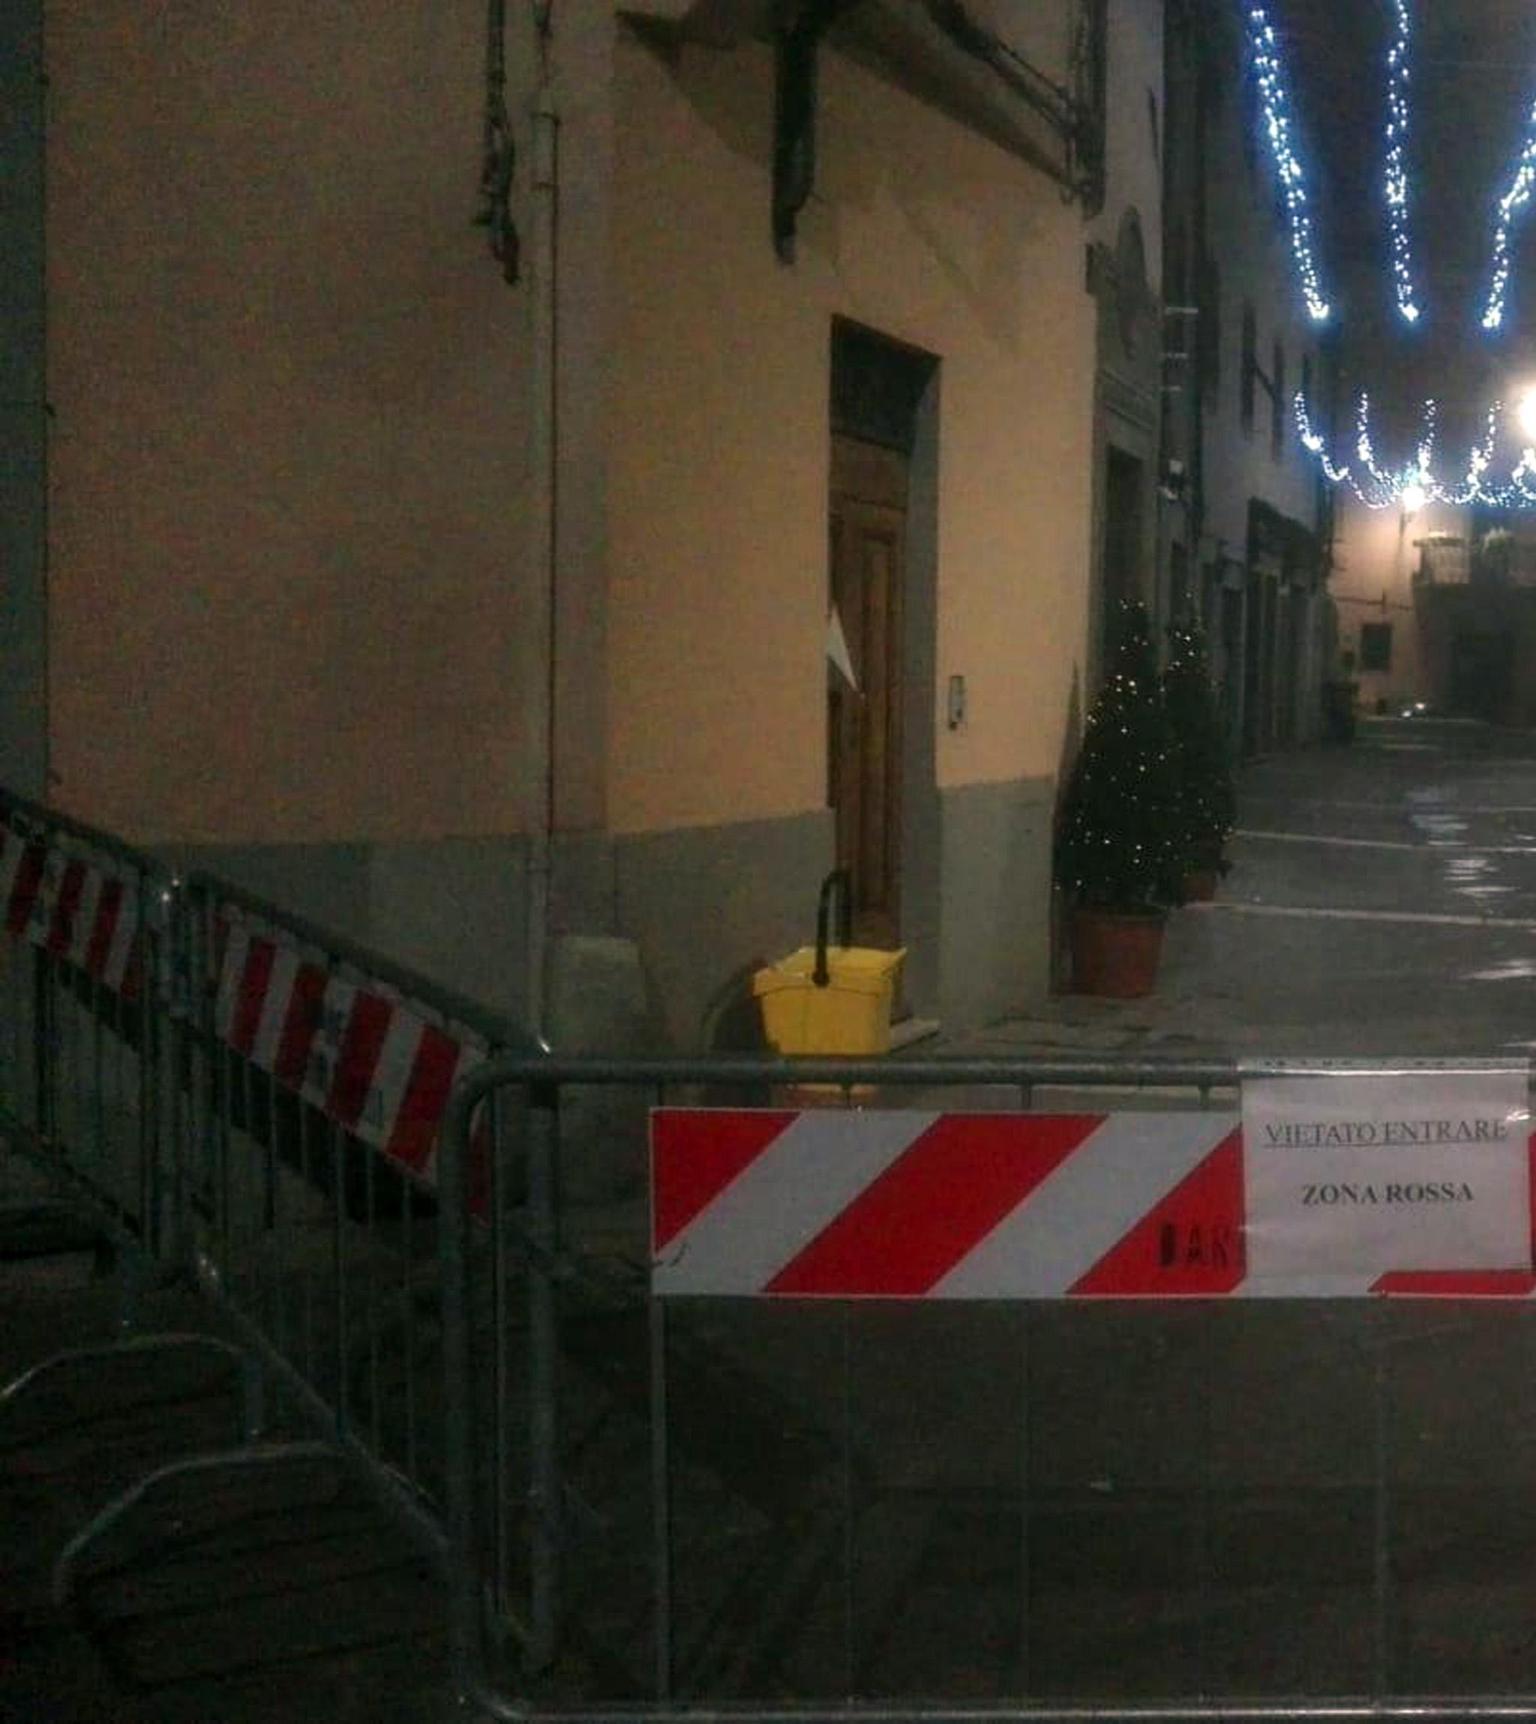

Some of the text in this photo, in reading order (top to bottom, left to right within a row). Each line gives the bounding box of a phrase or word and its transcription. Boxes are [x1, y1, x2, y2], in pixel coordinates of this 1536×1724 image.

[1265, 1119, 1507, 1145] VIETATO ENTRARE
[1302, 1181, 1475, 1205] ZONA ROSSA
